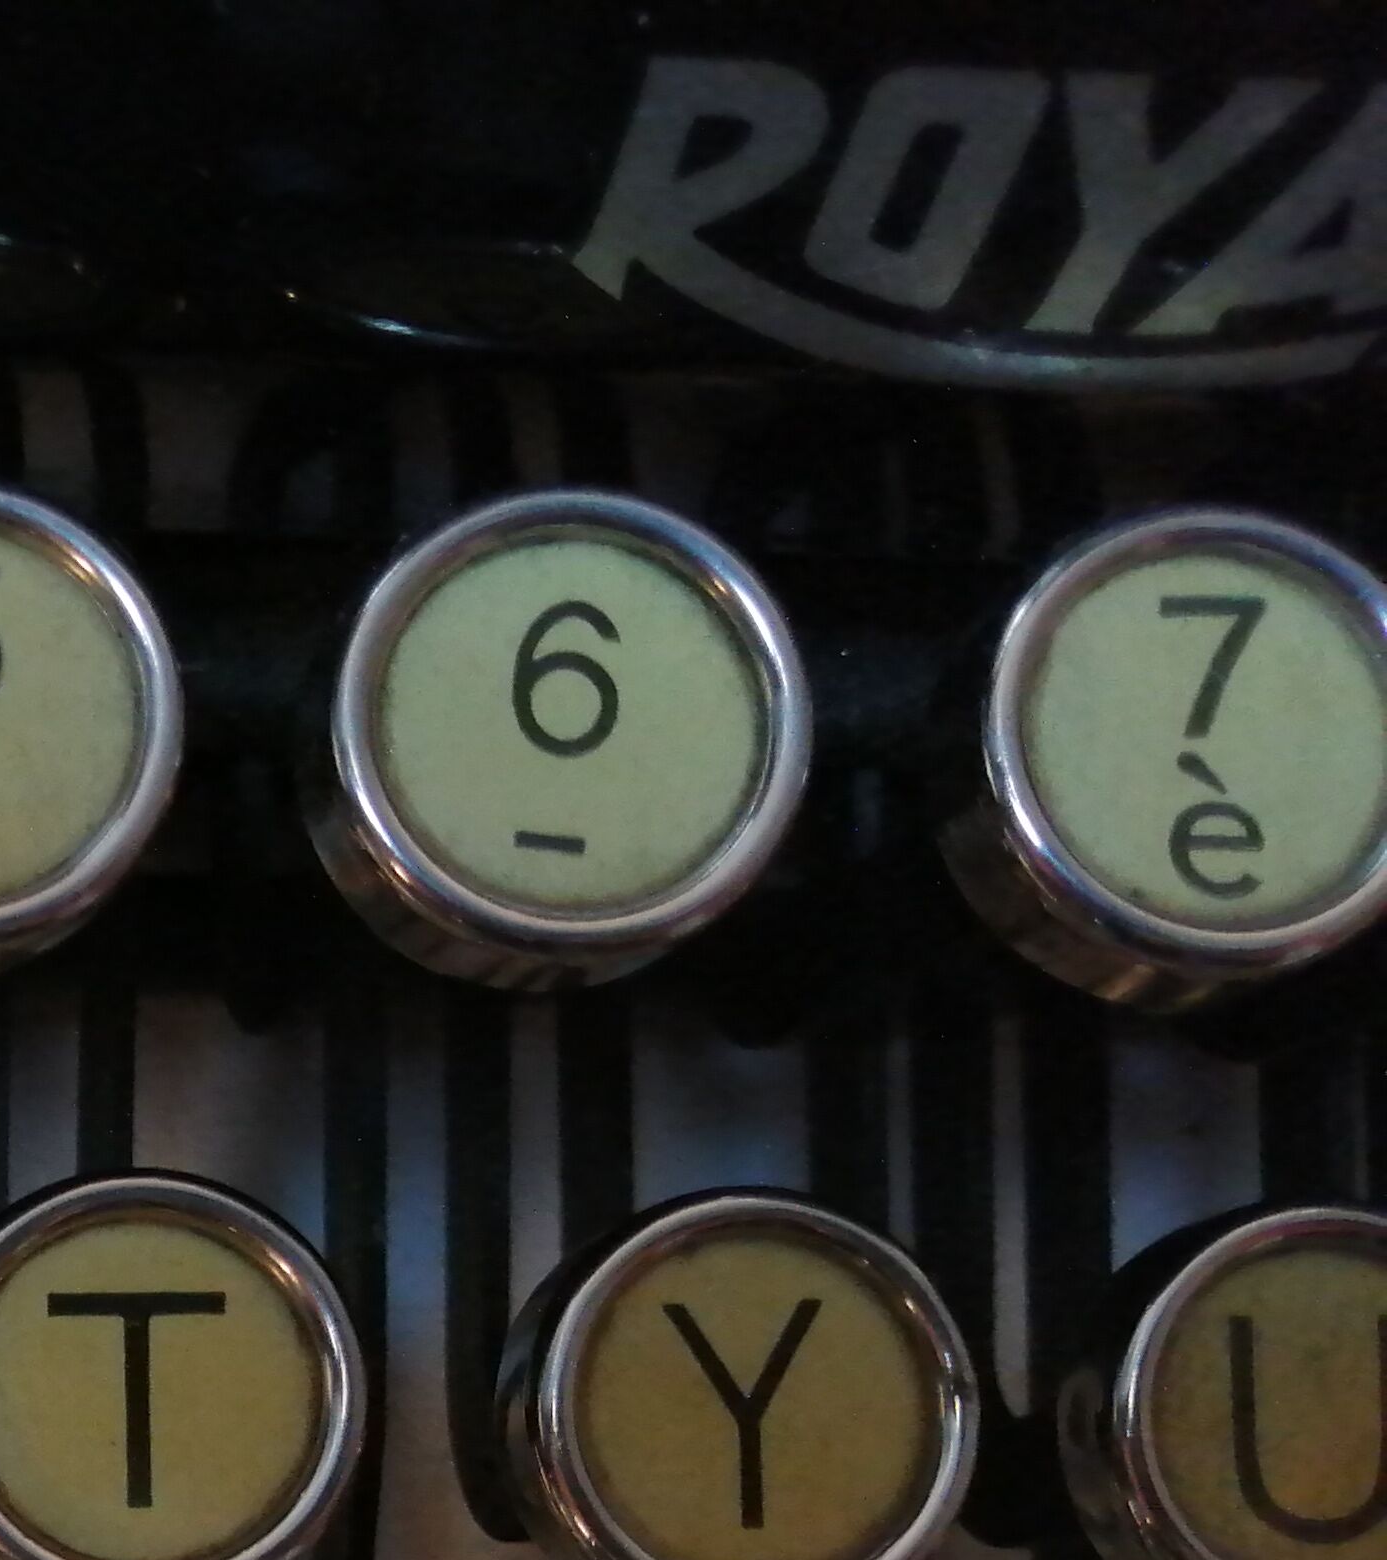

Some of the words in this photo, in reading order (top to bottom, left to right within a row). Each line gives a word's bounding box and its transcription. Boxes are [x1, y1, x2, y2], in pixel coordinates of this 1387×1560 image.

[512, 600, 620, 757] 6
[1158, 595, 1267, 739] 7
[1168, 751, 1266, 900] è
[48, 1292, 226, 1508] T
[663, 1299, 821, 1529] Y
[1228, 1314, 1387, 1546] U
